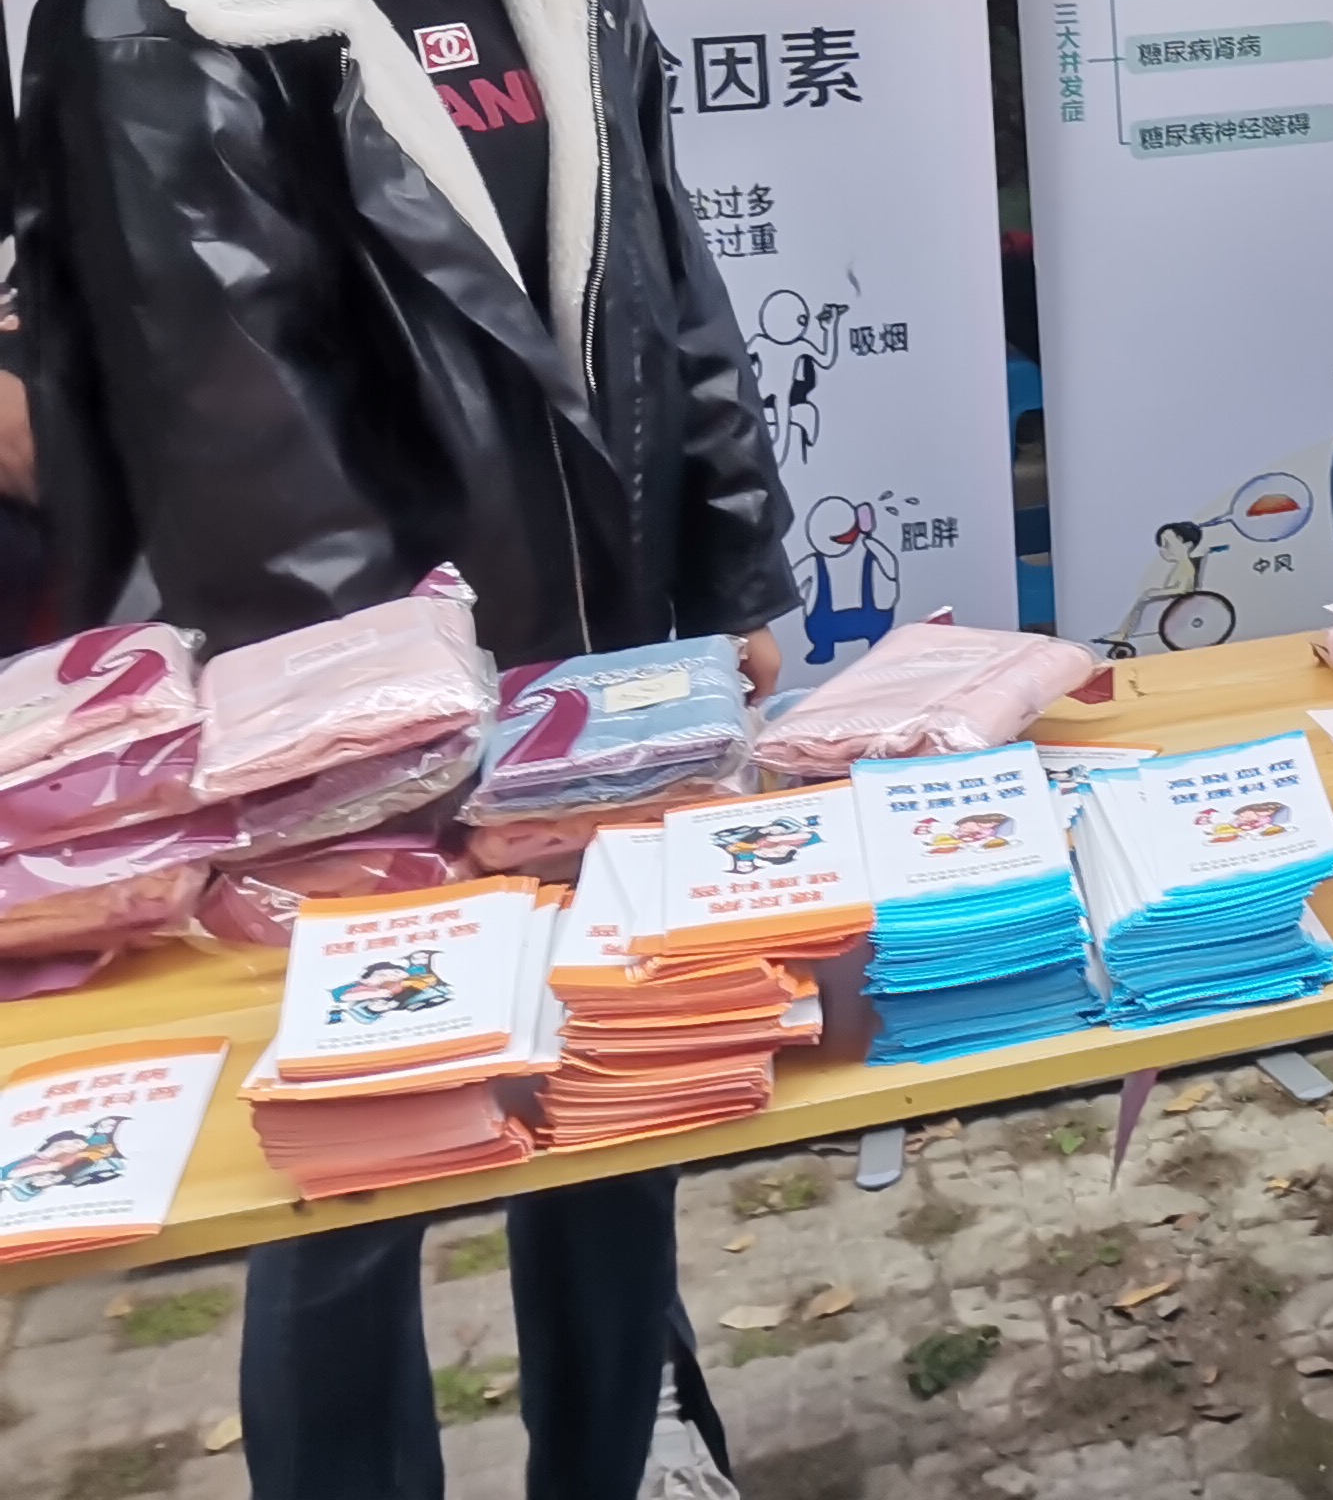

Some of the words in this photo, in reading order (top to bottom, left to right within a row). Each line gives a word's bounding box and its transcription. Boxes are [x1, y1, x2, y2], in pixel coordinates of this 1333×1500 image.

[1053, 2, 1086, 124] 三大并发症
[1136, 33, 1262, 67] 糖尿病肾病
[1138, 111, 1311, 151] 糖尿病神经障碍
[848, 322, 909, 357] 吸烟
[901, 517, 958, 553] 肥胖
[1252, 553, 1296, 575] 中风
